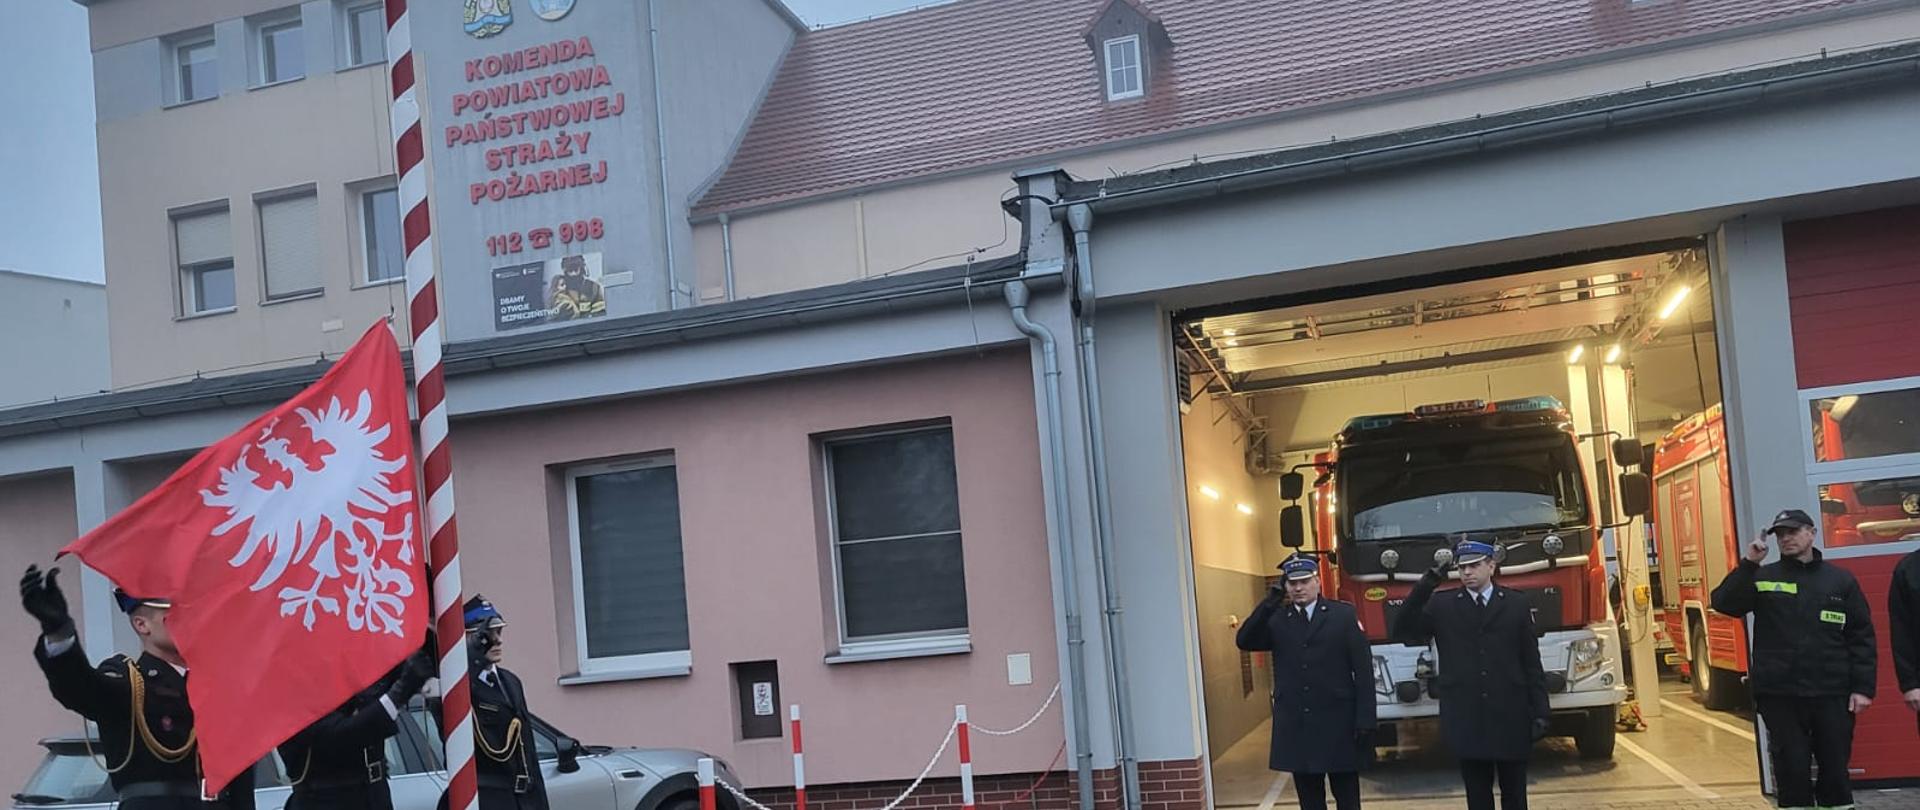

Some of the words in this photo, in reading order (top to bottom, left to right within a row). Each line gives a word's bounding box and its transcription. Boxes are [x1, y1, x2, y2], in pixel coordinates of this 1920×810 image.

[465, 36, 595, 82] KOMENDA
[453, 65, 612, 116] POWIATOWA
[445, 92, 625, 148] PAŃSTWOWEJ
[485, 131, 591, 171] STRAŻY
[470, 160, 608, 204] POŻARNEJ
[487, 232, 523, 257] 112
[559, 217, 604, 244] 998
